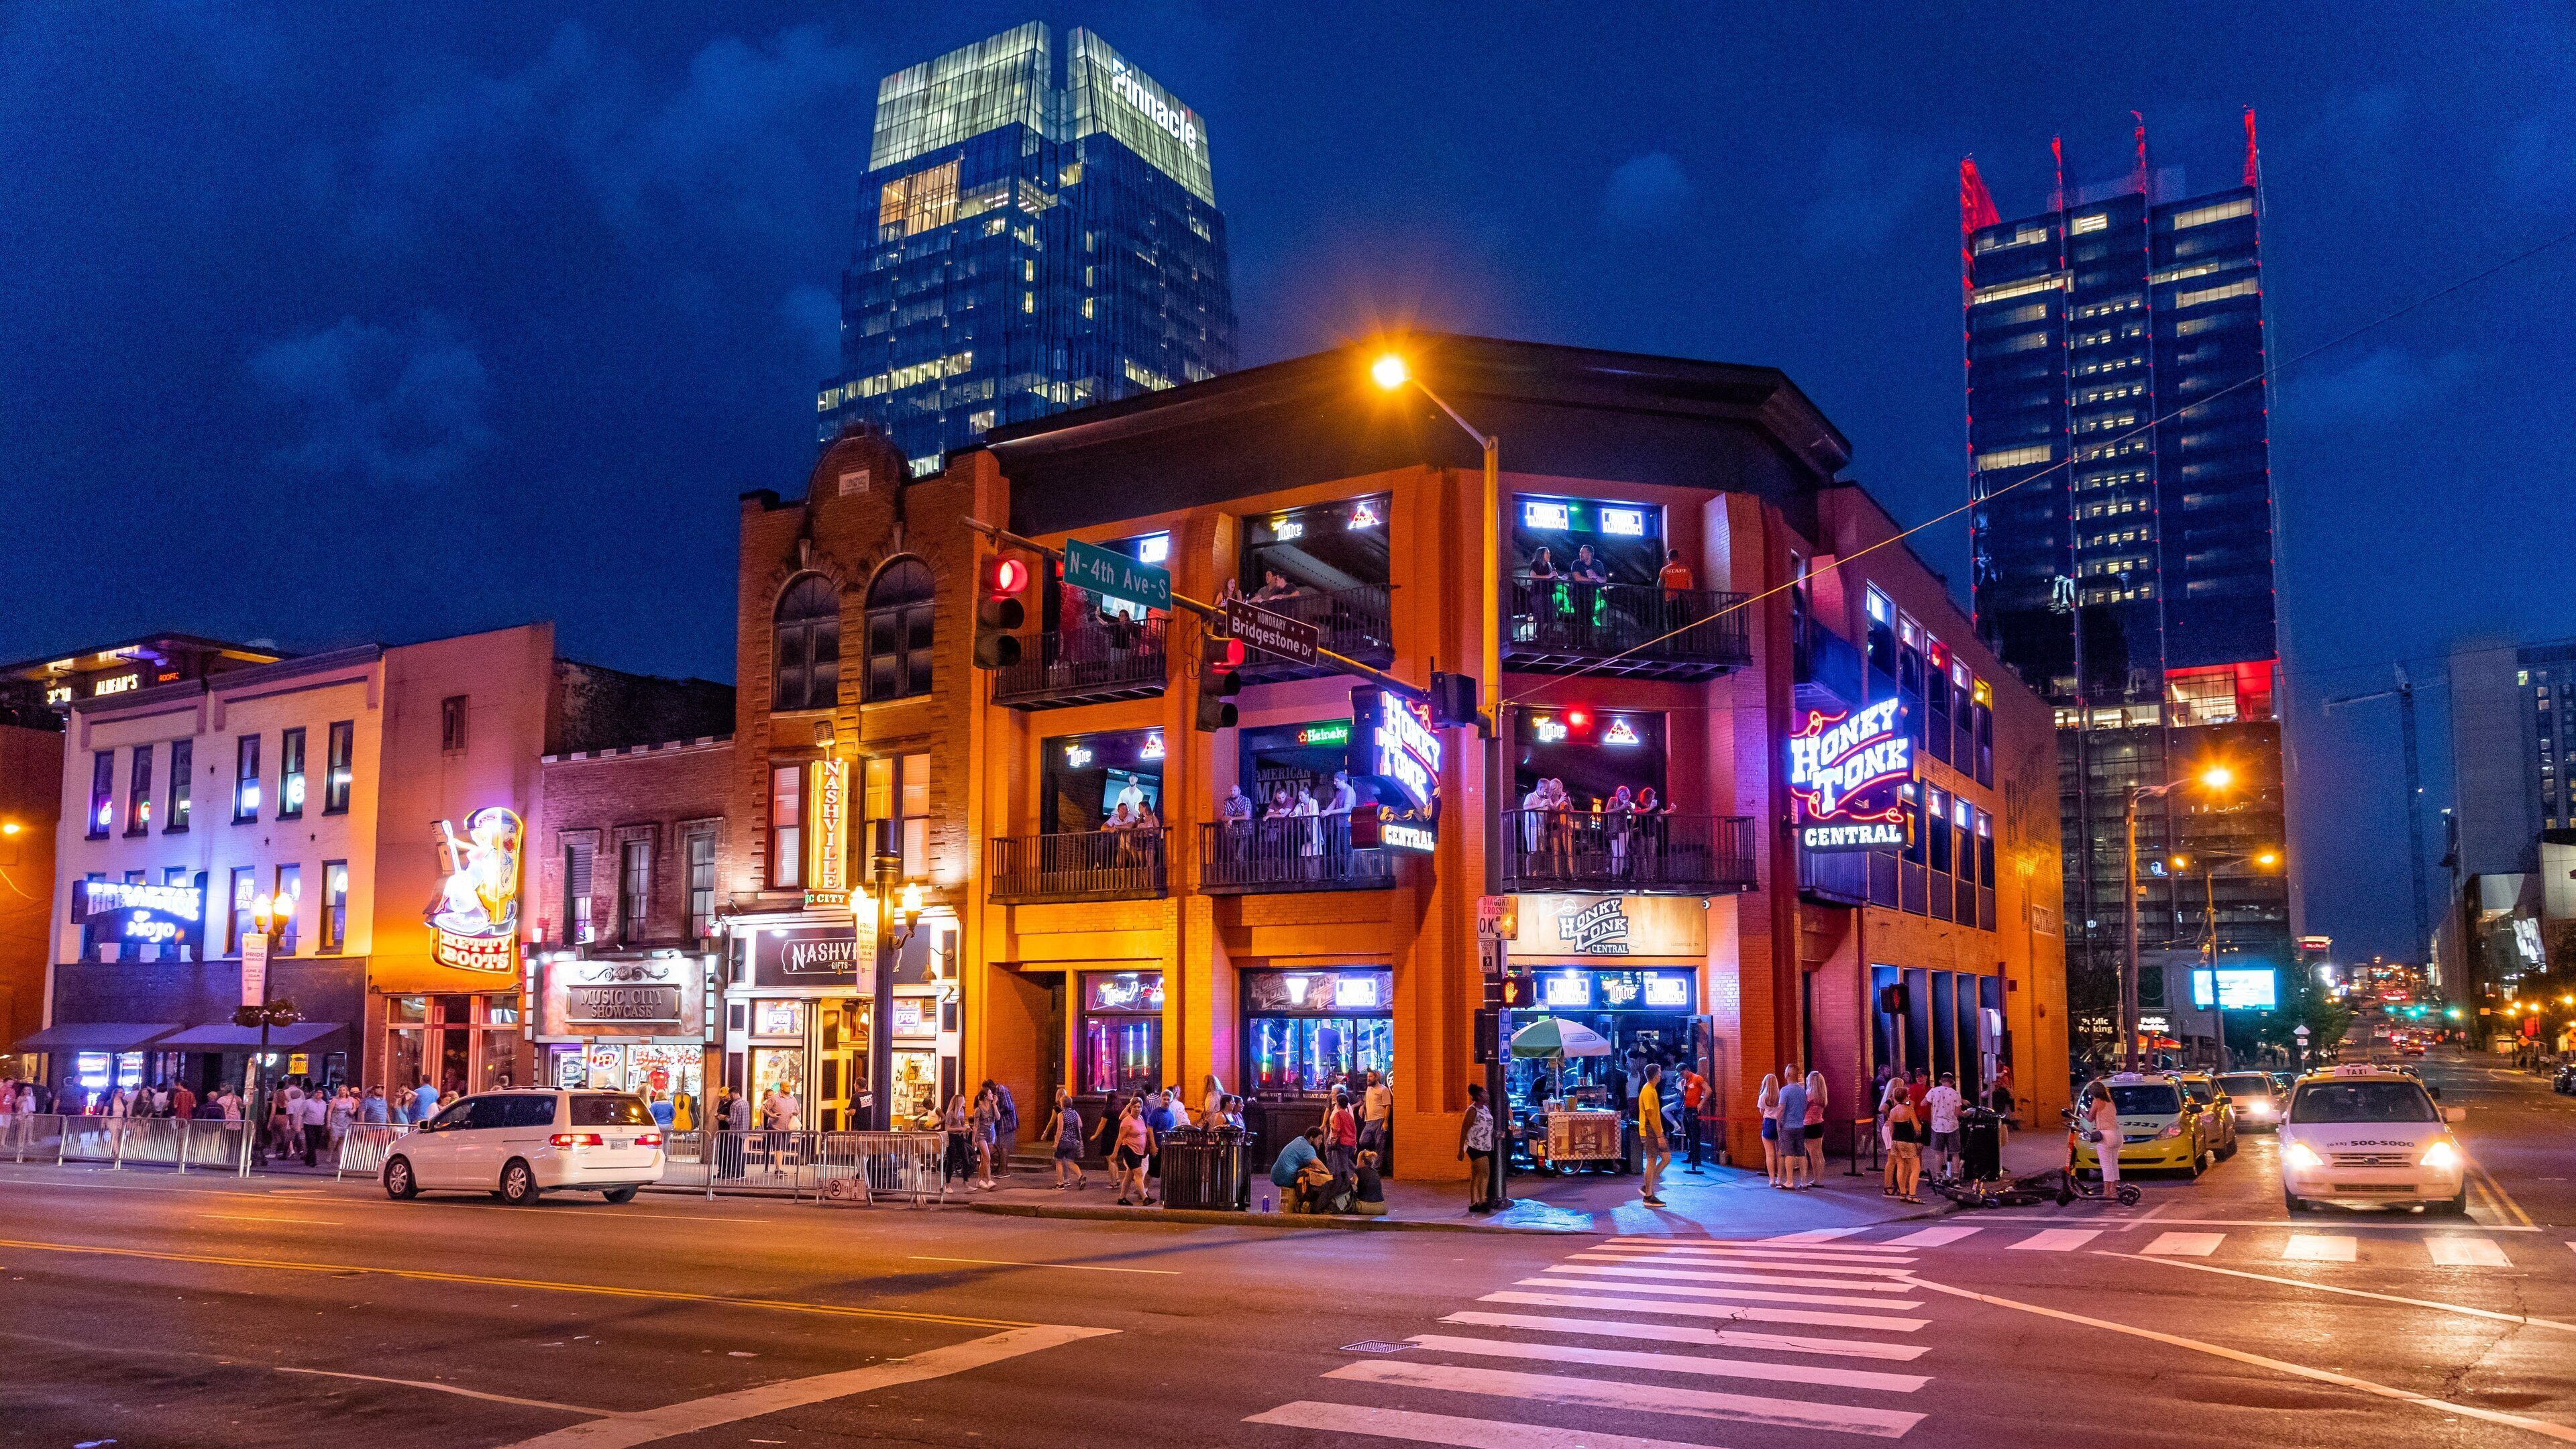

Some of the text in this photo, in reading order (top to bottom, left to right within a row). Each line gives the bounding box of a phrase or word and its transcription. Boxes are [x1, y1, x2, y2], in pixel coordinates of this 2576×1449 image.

[1112, 57, 1197, 150] Pinnacle
[1257, 611, 1287, 631] HONORARY
[1232, 616, 1312, 657] Bridgestone Dr
[1307, 727, 1348, 742] Heineke
[1383, 691, 1440, 772] HONKY
[1790, 697, 1898, 784] HONKY
[1256, 767, 1311, 781] AMERICAN
[1377, 727, 1428, 806] TONK
[1812, 737, 1909, 814] TONK
[822, 761, 841, 889] NASHVILLE
[1805, 824, 1902, 847] CENTRAL
[1385, 824, 1435, 851] CENTRAL
[816, 894, 845, 904] CITY
[1483, 898, 1514, 907] DIAGONAL
[1483, 906, 1513, 915] CROSSING
[1559, 900, 1620, 938] HONKY
[126, 921, 176, 943] MOJO
[1479, 918, 1495, 933] OK
[1572, 918, 1627, 951] TONK
[441, 931, 513, 953] BETTY
[1592, 945, 1628, 953] CENTRAL
[441, 946, 509, 969] BOOTS
[792, 942, 857, 971] NASHVI
[831, 961, 849, 969] GIFTS
[581, 989, 665, 1006] MUSIC CITY
[591, 1006, 653, 1018] SHOWCASE
[2078, 1026, 2113, 1034] Paking
[590, 1054, 616, 1067] OPEN
